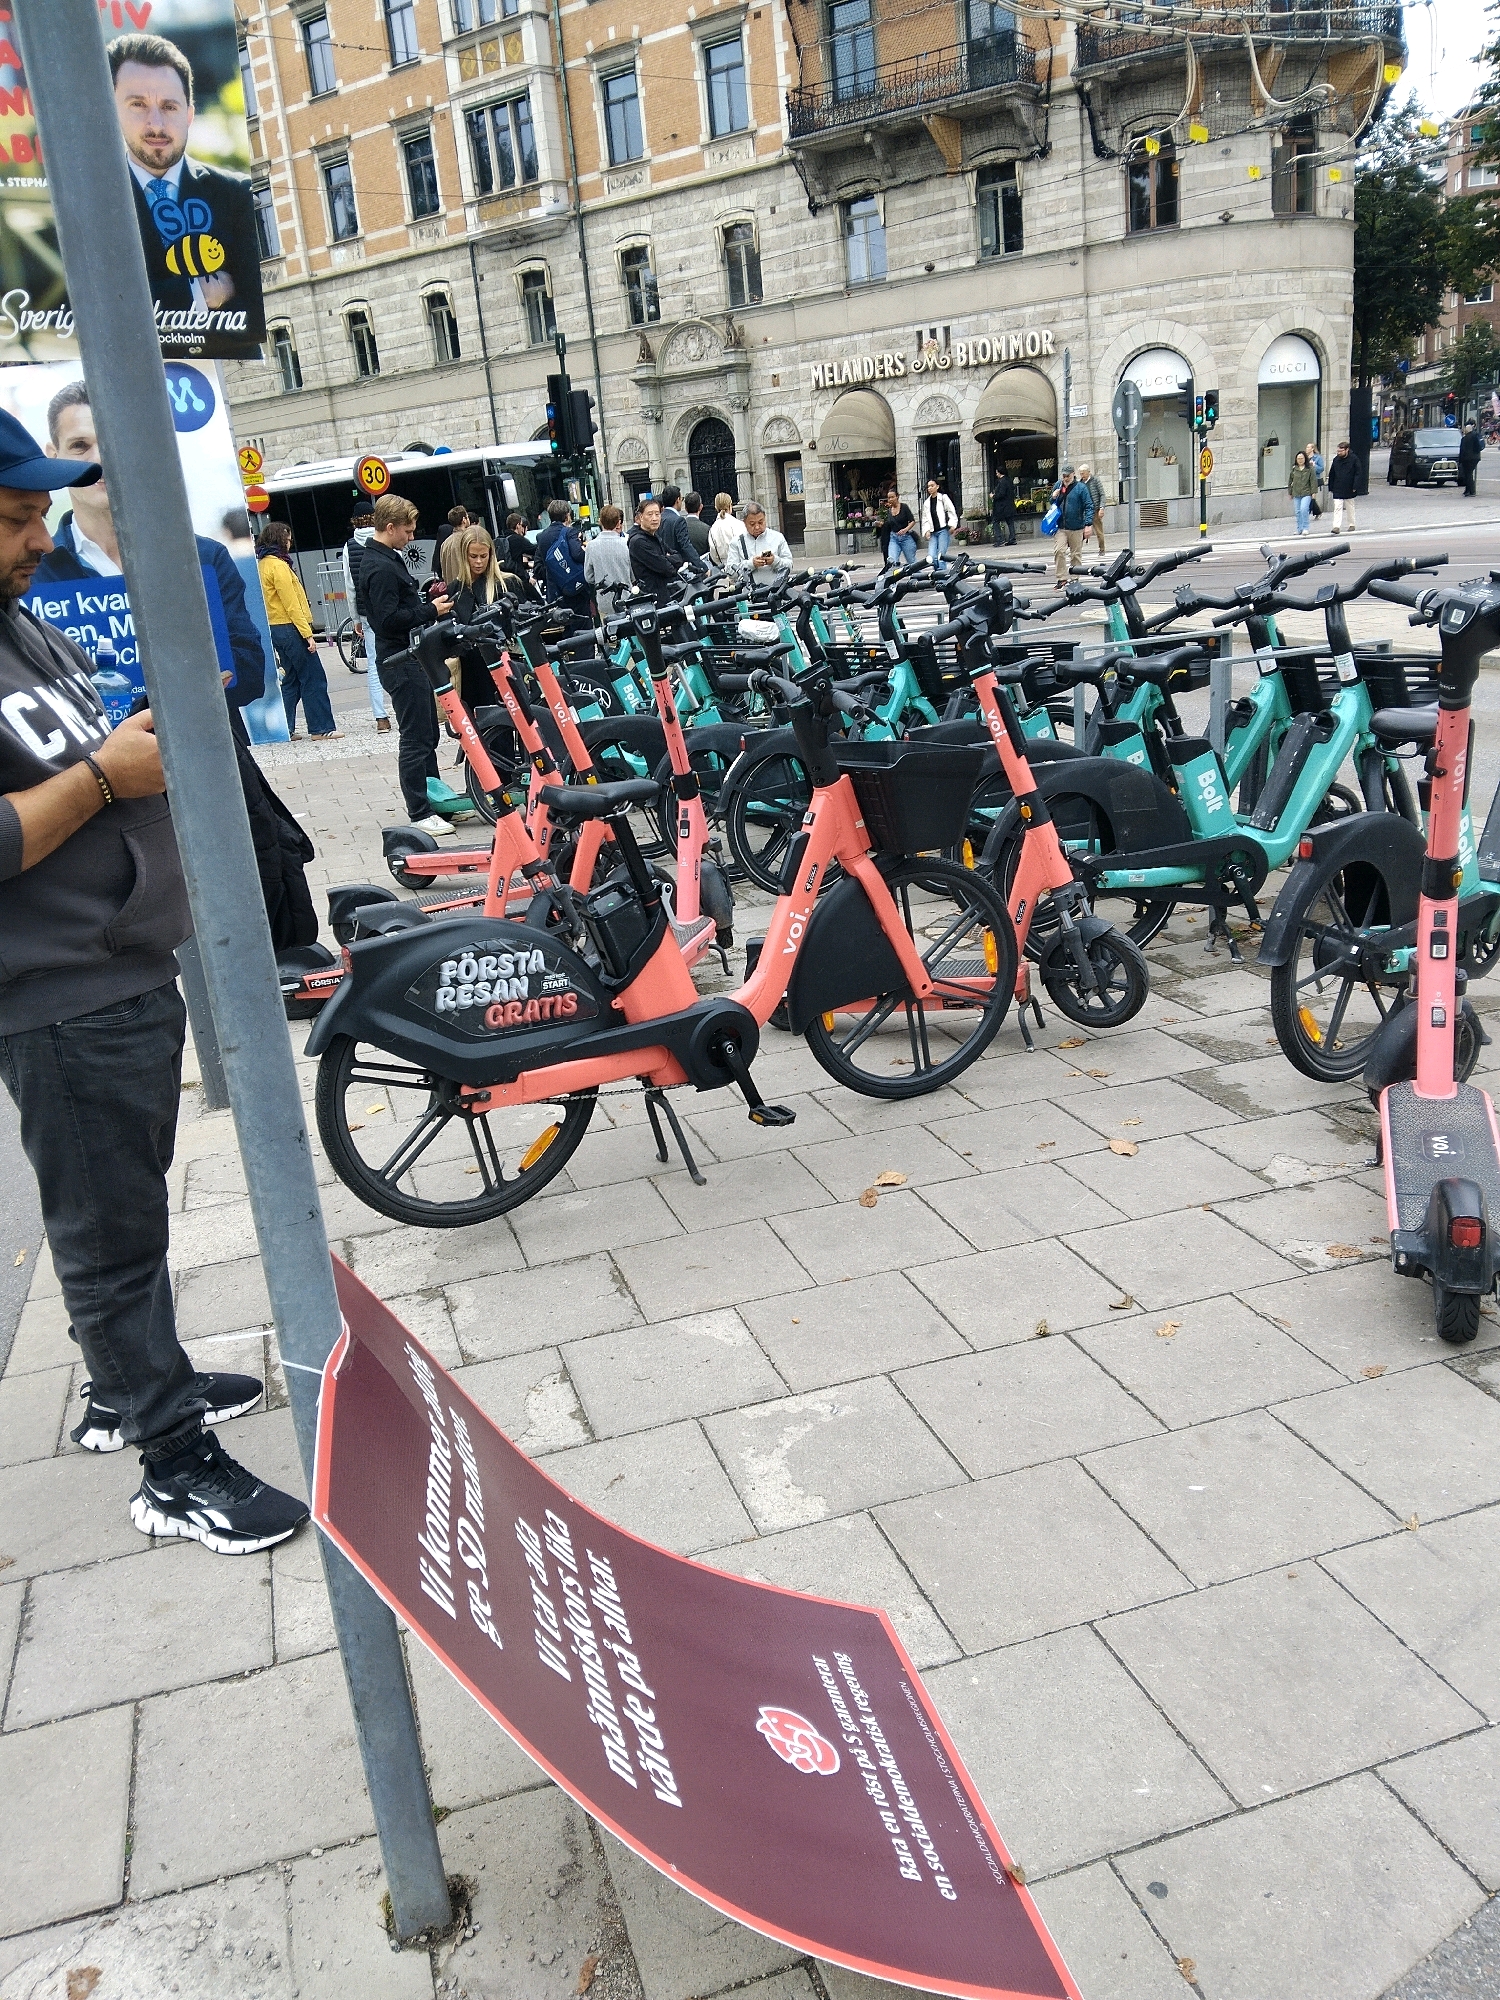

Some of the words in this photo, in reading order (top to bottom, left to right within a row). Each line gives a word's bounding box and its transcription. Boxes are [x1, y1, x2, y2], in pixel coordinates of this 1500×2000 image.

[156, 202, 209, 237] SD
[158, 332, 206, 345] ockholm
[956, 329, 1056, 367] BLOMMOR
[810, 352, 906, 390] MELANDERS
[1136, 374, 1179, 389] GUCCI
[1269, 362, 1307, 374] GUCCI
[363, 466, 385, 484] 30
[1202, 455, 1212, 468] 30
[503, 691, 520, 716] voi.
[553, 701, 571, 728] voi.
[987, 708, 1007, 743] voi.
[1197, 768, 1225, 814] Bolt
[782, 907, 810, 954] voi.
[439, 949, 546, 987] FÖRSTA
[542, 978, 570, 990] START
[434, 975, 530, 1013] RESAN
[484, 992, 579, 1030] GRATIS
[1431, 1135, 1457, 1158] voi.
[417, 1410, 452, 1579] kommer
[457, 1516, 489, 1591] SD
[514, 1516, 549, 1586] alla
[542, 1508, 579, 1574] lika
[417, 1556, 457, 1621] Vi
[586, 1548, 633, 1645] allvar.
[466, 1579, 504, 1650] ge
[528, 1575, 562, 1642] tar
[534, 1628, 572, 1682] Vi
[603, 1639, 656, 1700] på
[557, 1566, 638, 1789] människors
[811, 1654, 860, 1733] garanterar
[832, 1651, 873, 1713] regering
[623, 1694, 683, 1808] värde
[841, 1733, 863, 1746] S
[848, 1747, 877, 1771] på
[859, 1714, 945, 1873] socialdemokratisk
[860, 1770, 890, 1808] röst
[879, 1810, 901, 1834] en
[891, 1837, 923, 1882] Bara
[934, 1875, 957, 1901] en
